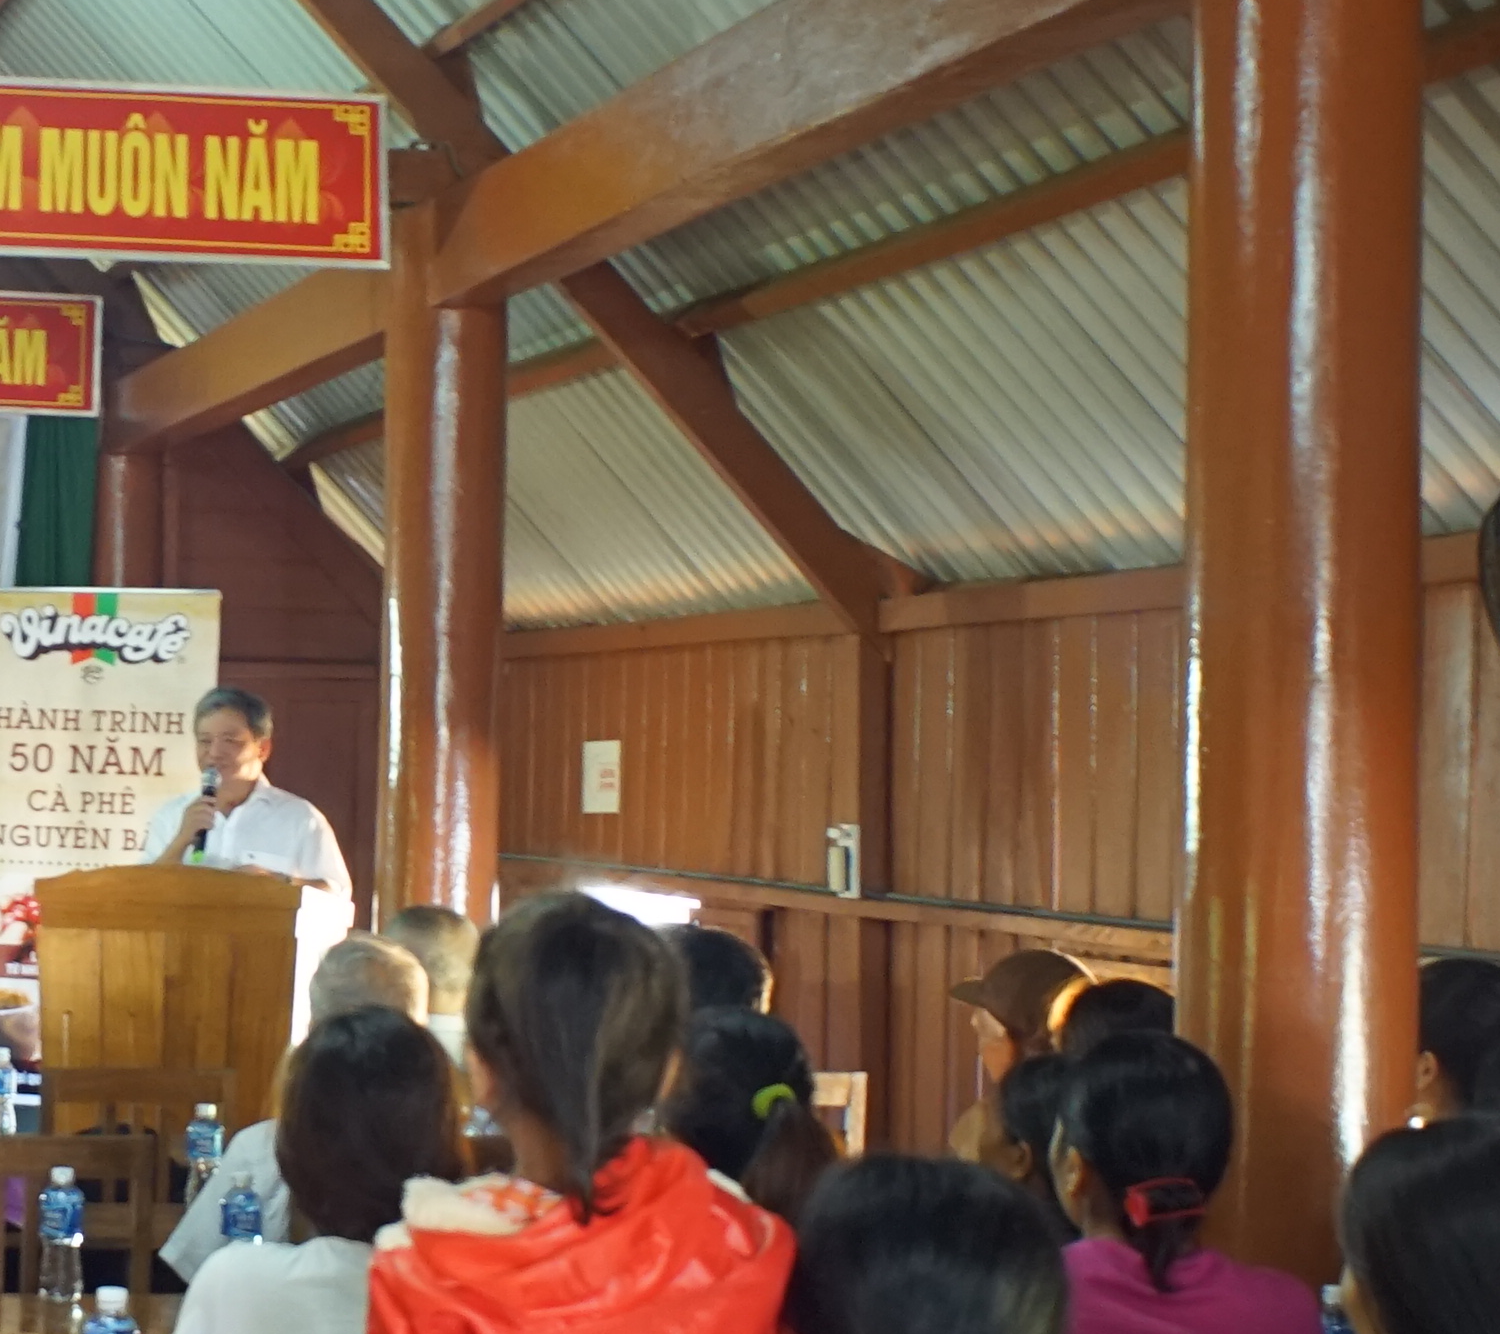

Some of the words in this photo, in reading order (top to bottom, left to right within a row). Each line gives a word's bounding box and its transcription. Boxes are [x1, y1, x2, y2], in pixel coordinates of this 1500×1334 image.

[39, 113, 190, 219] MUÔN
[204, 119, 320, 224] NĂM
[1, 605, 192, 664] Vinacafé
[92, 703, 186, 736] TRÌNH
[9, 743, 54, 775] 50
[69, 738, 165, 778] NĂM
[28, 782, 69, 813] CÀ
[80, 786, 136, 816] PHÊ
